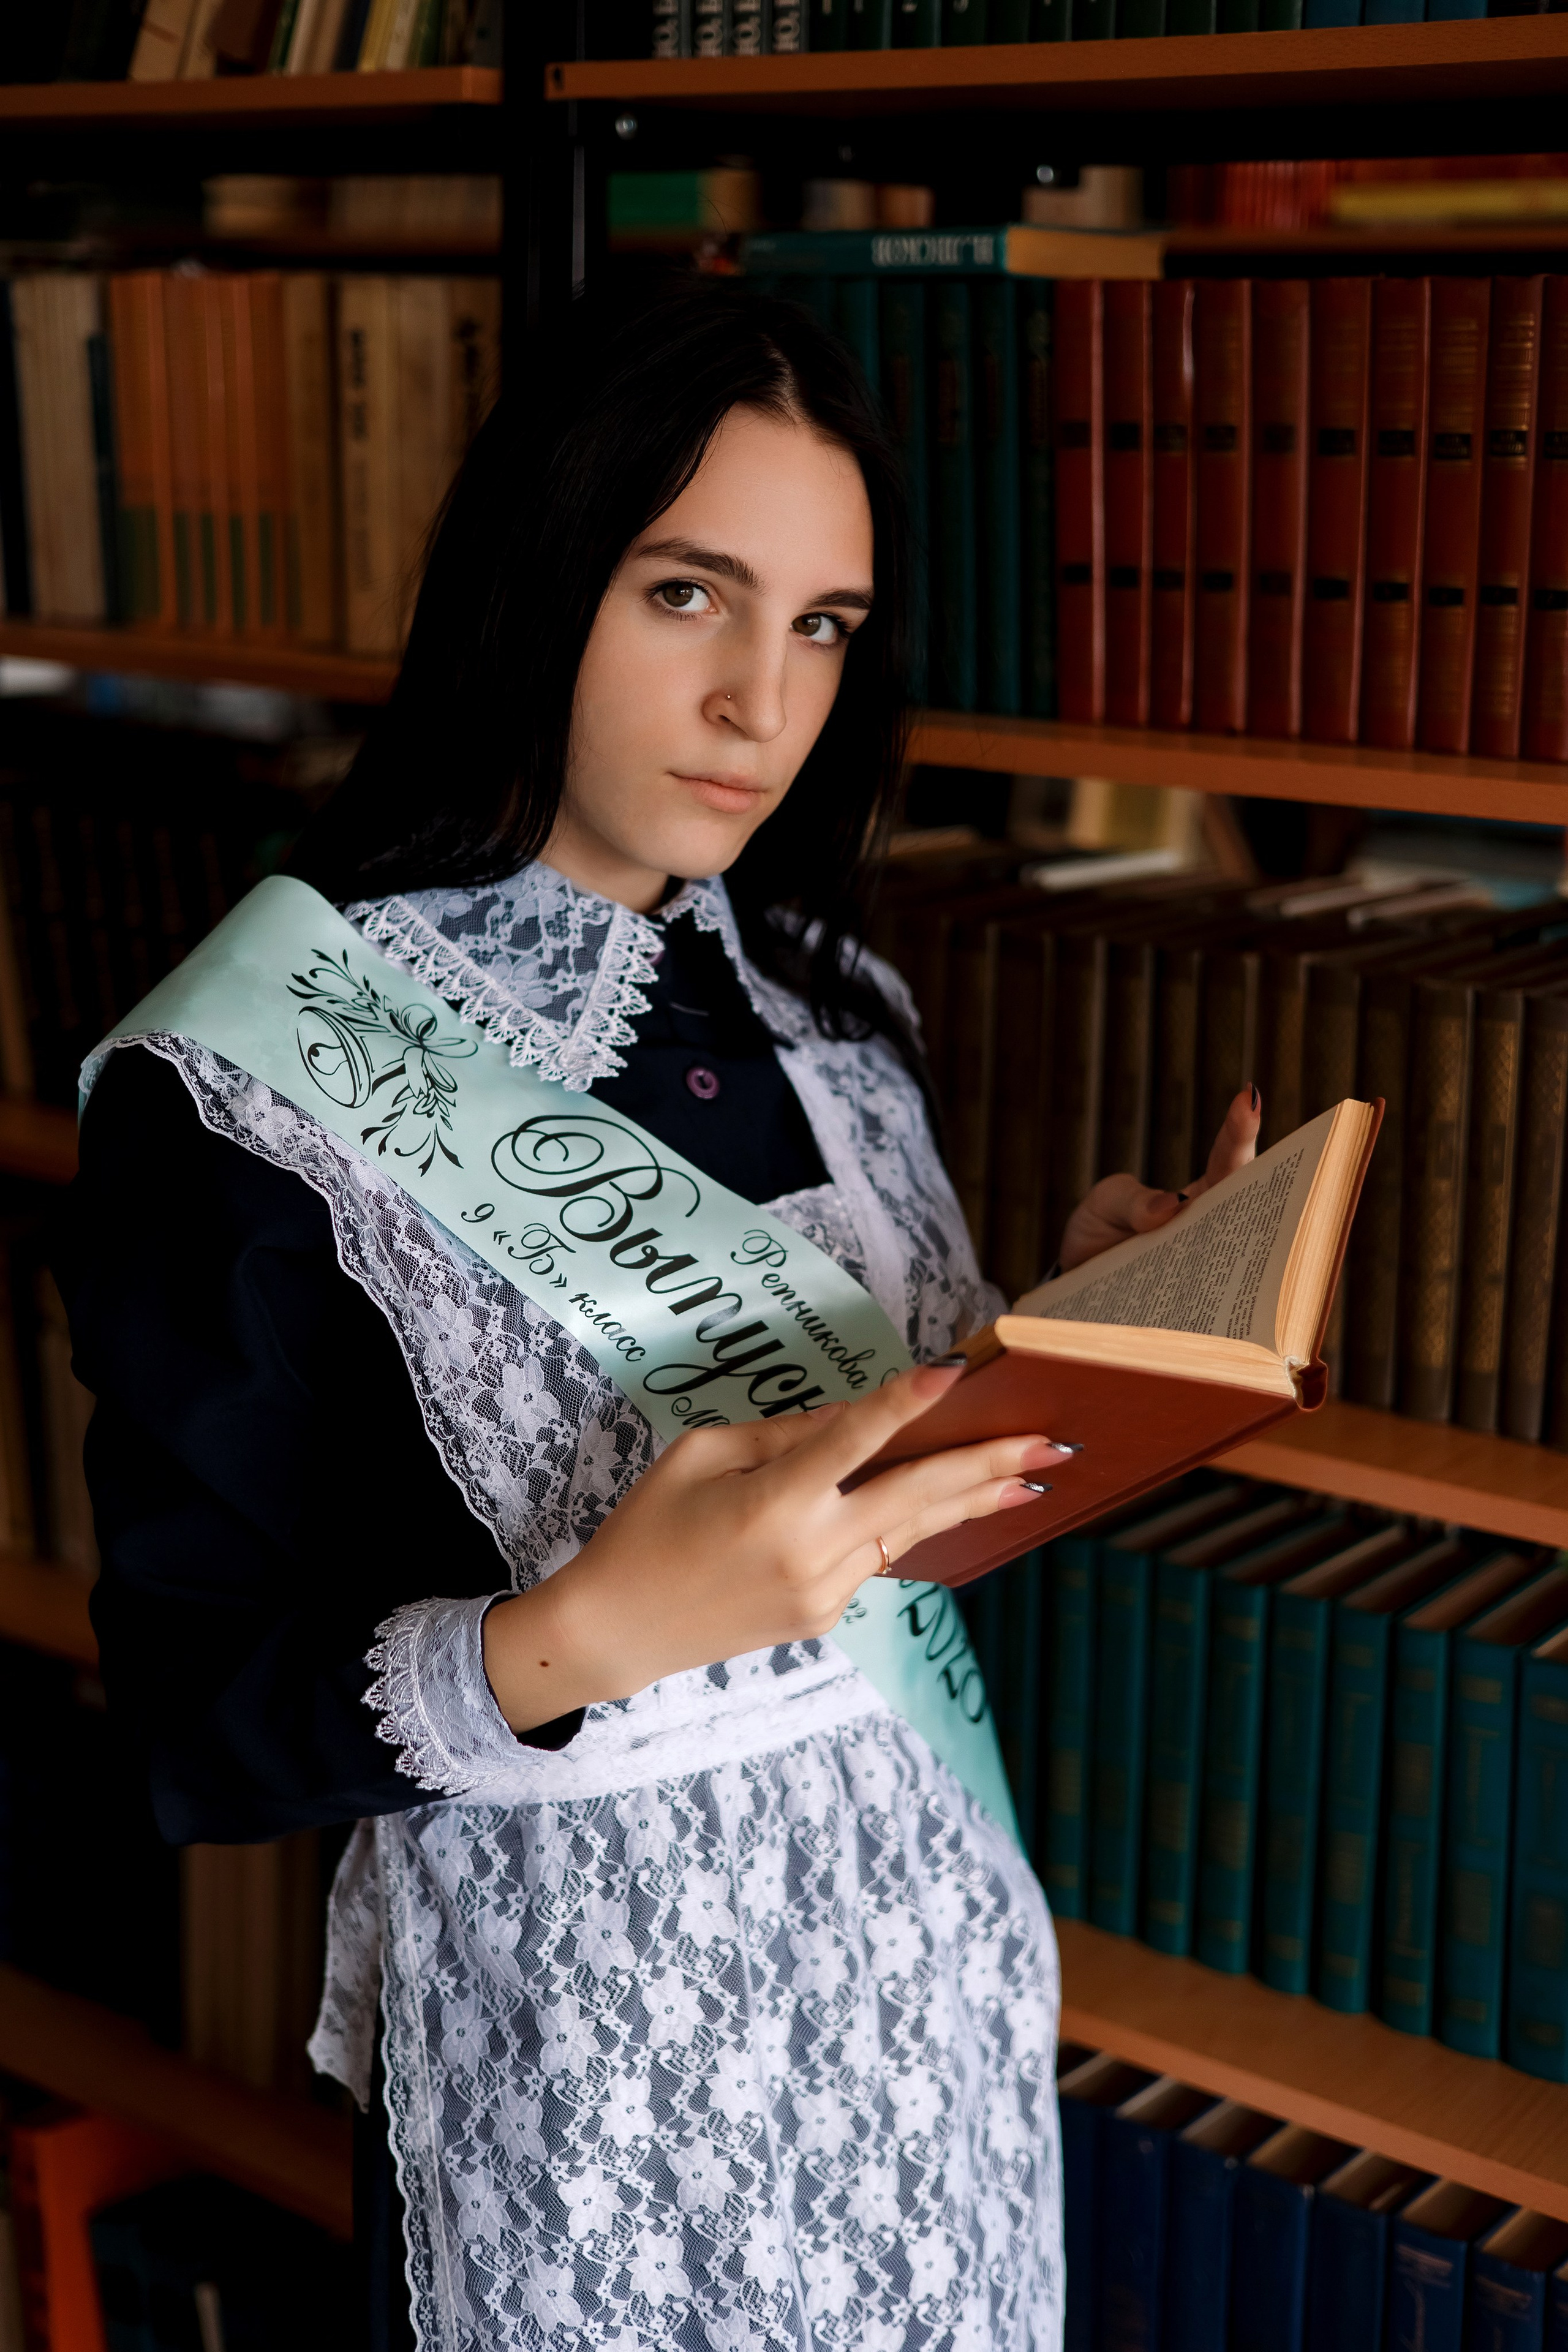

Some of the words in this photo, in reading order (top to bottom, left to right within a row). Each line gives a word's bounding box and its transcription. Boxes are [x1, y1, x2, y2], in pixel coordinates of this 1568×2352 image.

[461, 1203, 496, 1223] 9
[492, 1223, 575, 1289] «Б»
[570, 1292, 646, 1362] класс
[731, 1229, 875, 1390] Репникова
[1245, 1295, 1256, 1336] разговоров
